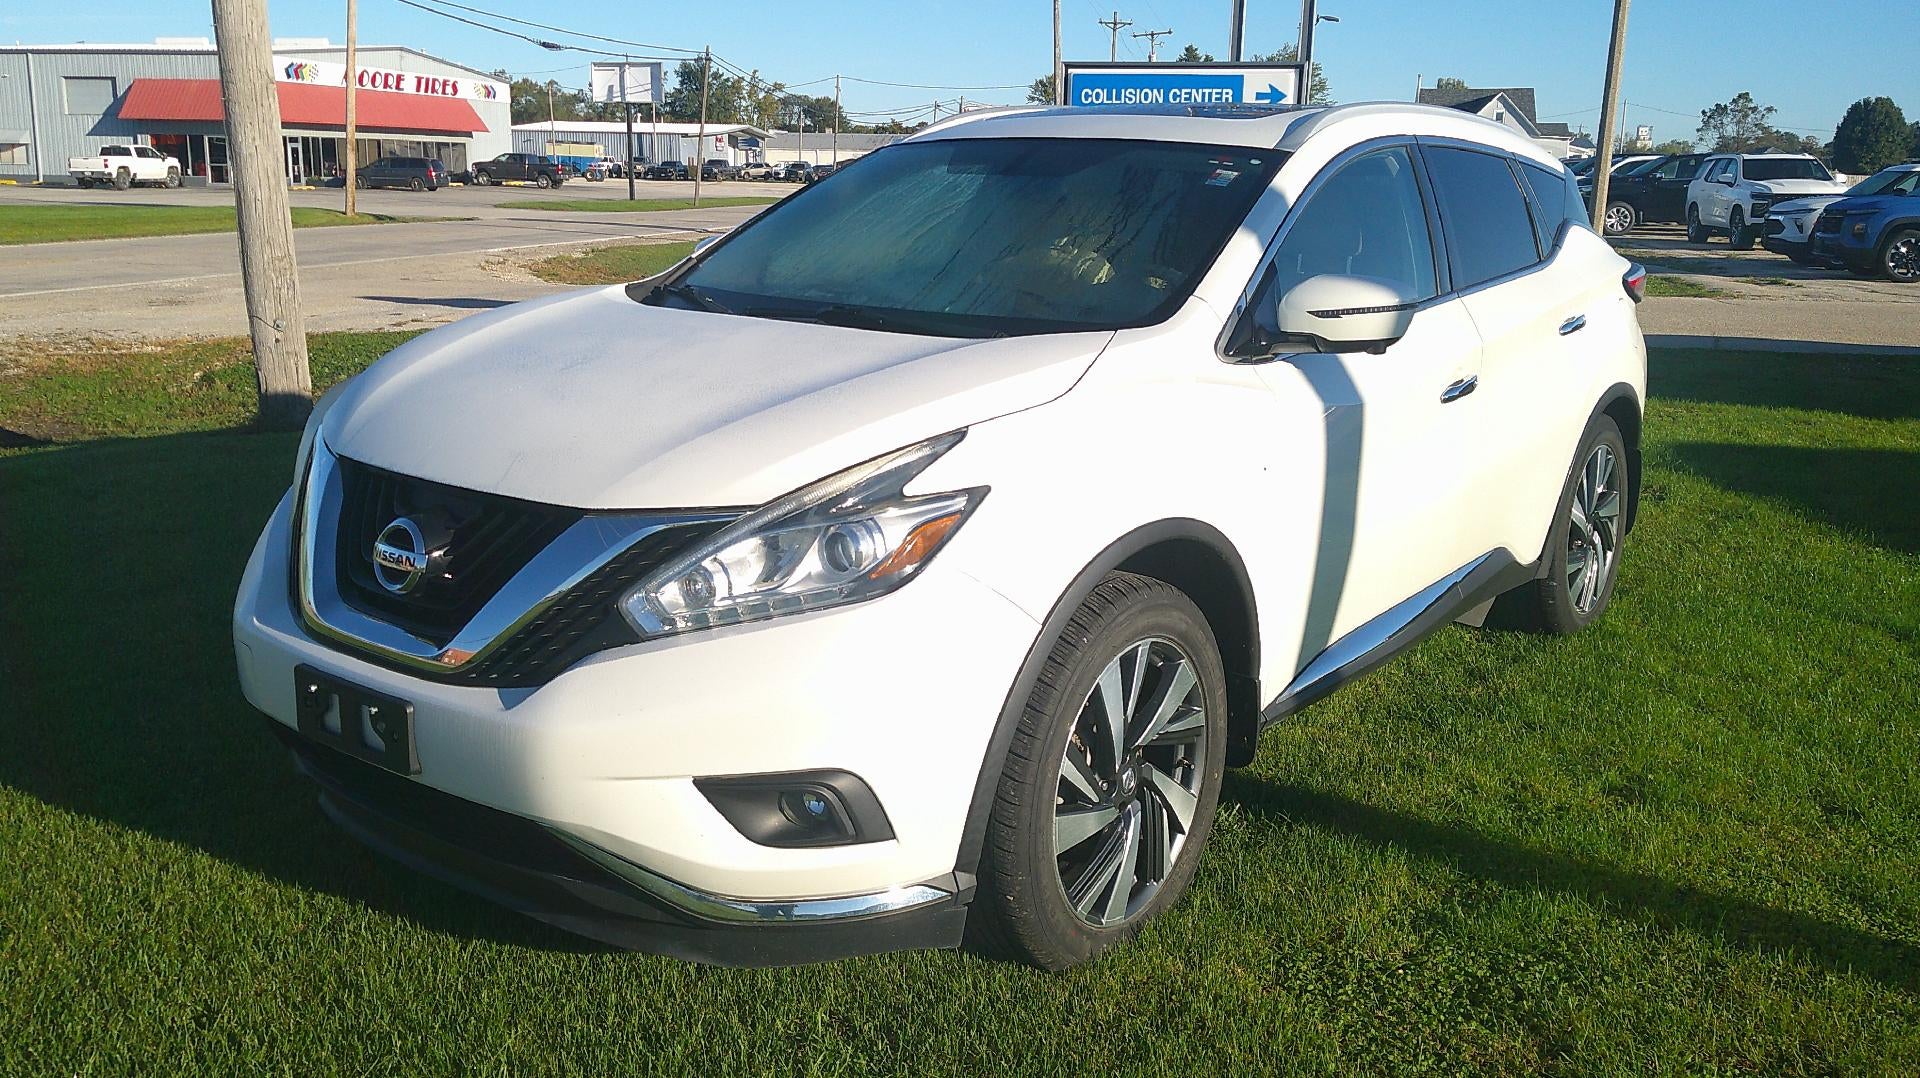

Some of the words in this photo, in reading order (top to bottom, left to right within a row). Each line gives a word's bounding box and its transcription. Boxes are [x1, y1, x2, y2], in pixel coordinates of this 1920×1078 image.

[414, 75, 458, 97] TIRES
[1081, 88, 1164, 104] COLLISION
[1168, 88, 1233, 104] CENTER
[374, 545, 416, 568] NISSAN
